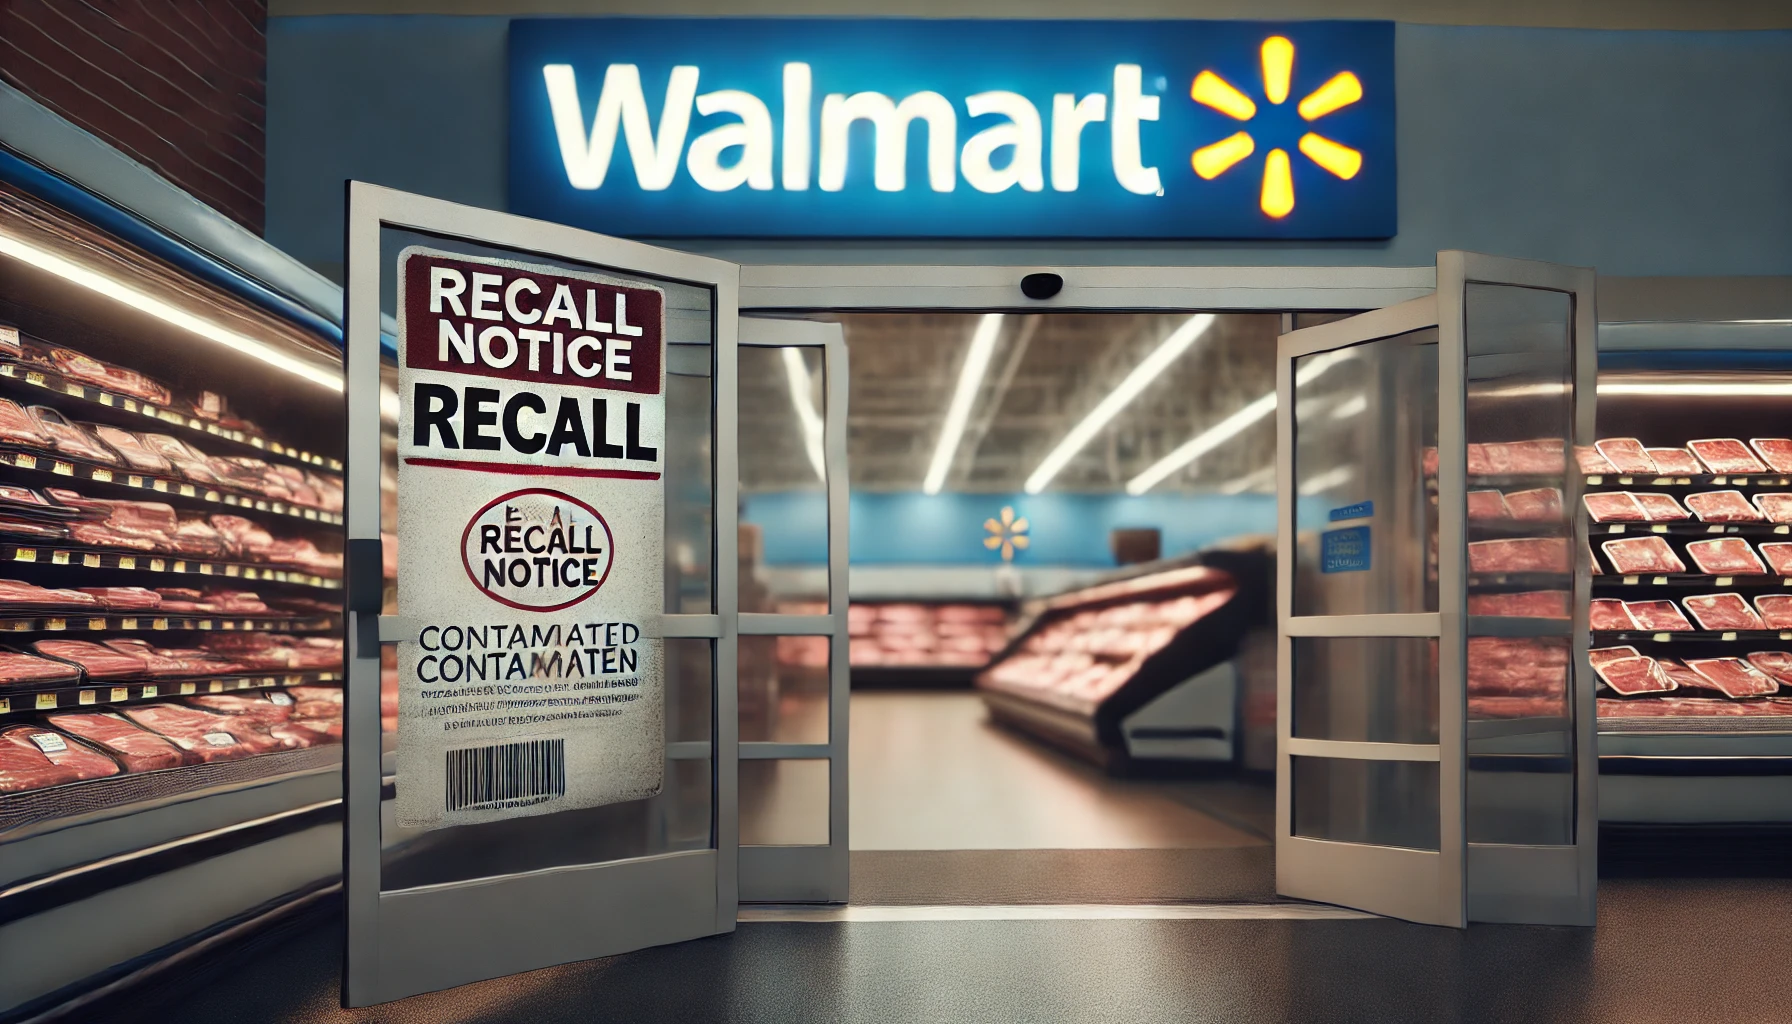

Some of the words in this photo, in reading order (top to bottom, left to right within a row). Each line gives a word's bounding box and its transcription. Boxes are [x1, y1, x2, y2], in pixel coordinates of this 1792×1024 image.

[543, 62, 1161, 194] Walmart
[430, 266, 643, 337] RECALL
[438, 318, 632, 381] NOTICE
[413, 382, 658, 462] RECALL
[480, 524, 602, 555] RECALL
[484, 557, 599, 588] NOTICE
